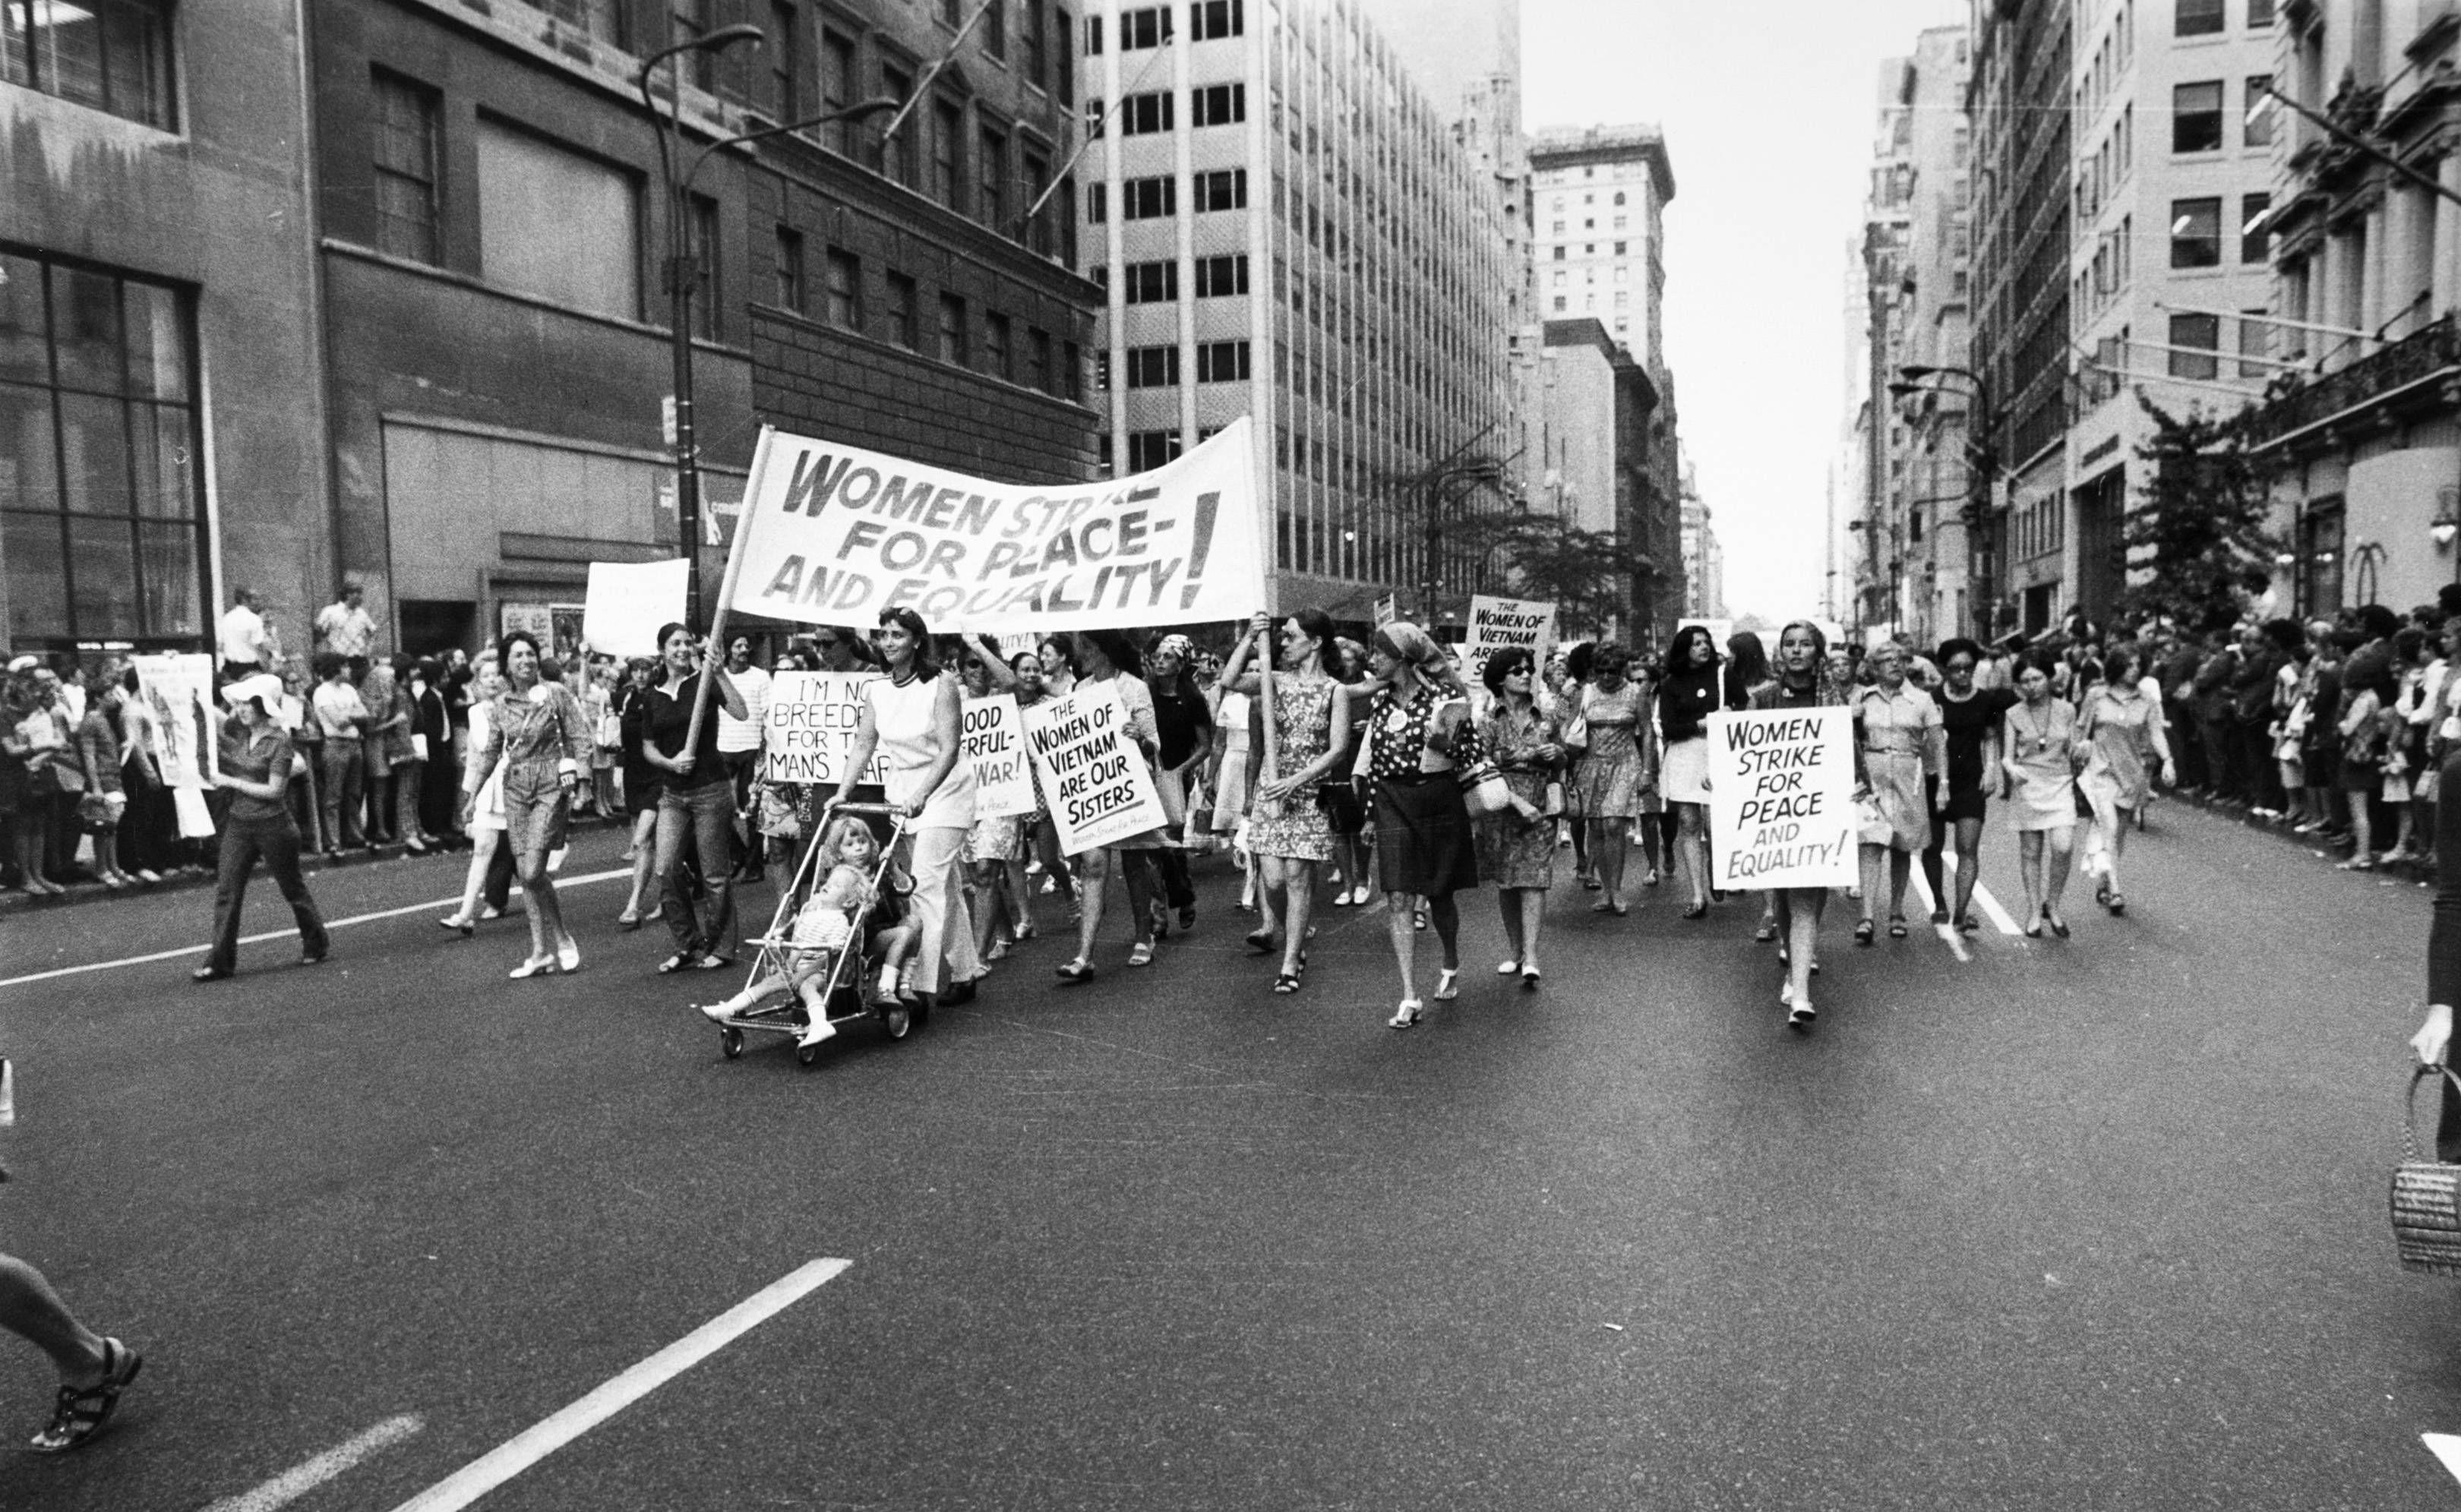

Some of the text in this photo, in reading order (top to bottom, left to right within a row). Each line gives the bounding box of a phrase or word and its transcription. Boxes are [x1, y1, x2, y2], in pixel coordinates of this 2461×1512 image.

[782, 449, 1001, 535] WOMEN
[836, 521, 965, 578] FOR
[762, 554, 875, 611] AND
[1476, 609, 1546, 629] WOMEN OF
[1497, 603, 1518, 612] THE
[1000, 633, 1029, 650] LITY!
[1480, 627, 1537, 644] VIETNAM
[800, 678, 828, 702] I'M
[774, 703, 864, 728] BREED
[965, 706, 1002, 734] OOD
[1050, 699, 1076, 721] THE
[788, 730, 828, 748] FOR
[1031, 703, 1112, 754] WOMEN OF
[1726, 718, 1823, 752] WOMEN
[962, 731, 1015, 757] RFUL-
[1048, 731, 1117, 775] VIETNAM
[769, 752, 829, 780] MAN'S
[974, 751, 1022, 788] WAR!
[1737, 744, 1824, 776] STRIKE
[1060, 756, 1129, 802] ARE OUR
[1755, 772, 1803, 797] FOR
[1068, 779, 1134, 825] SISTERS
[1738, 791, 1823, 830] PEACE
[1752, 823, 1800, 848] AND
[1727, 829, 1848, 880] EQUALITY!
